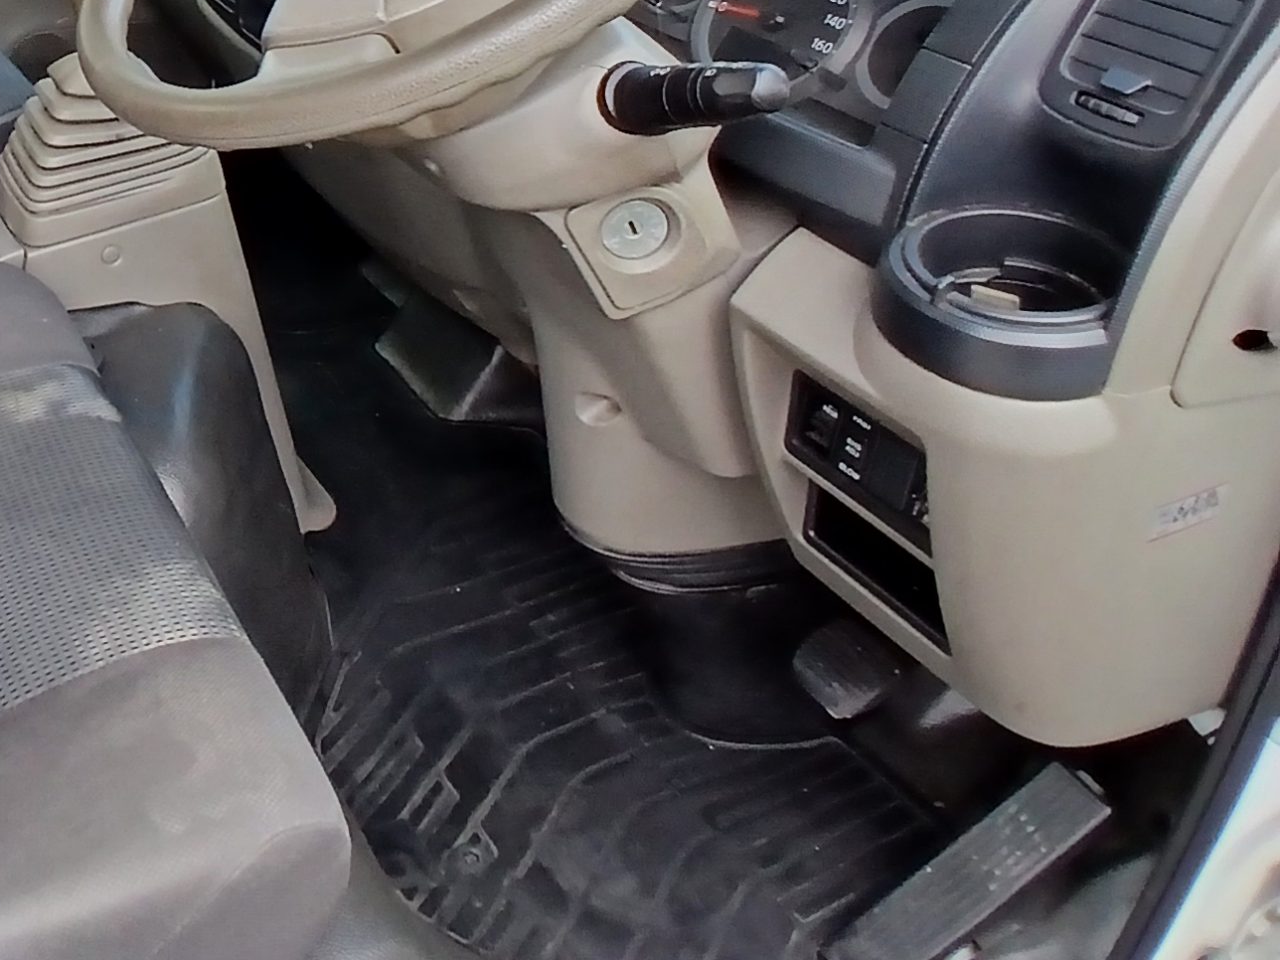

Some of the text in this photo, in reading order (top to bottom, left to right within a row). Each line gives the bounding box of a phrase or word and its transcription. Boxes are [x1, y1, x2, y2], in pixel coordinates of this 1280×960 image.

[718, 1, 728, 12] 0
[824, 14, 847, 30] 140
[811, 38, 834, 54] 160
